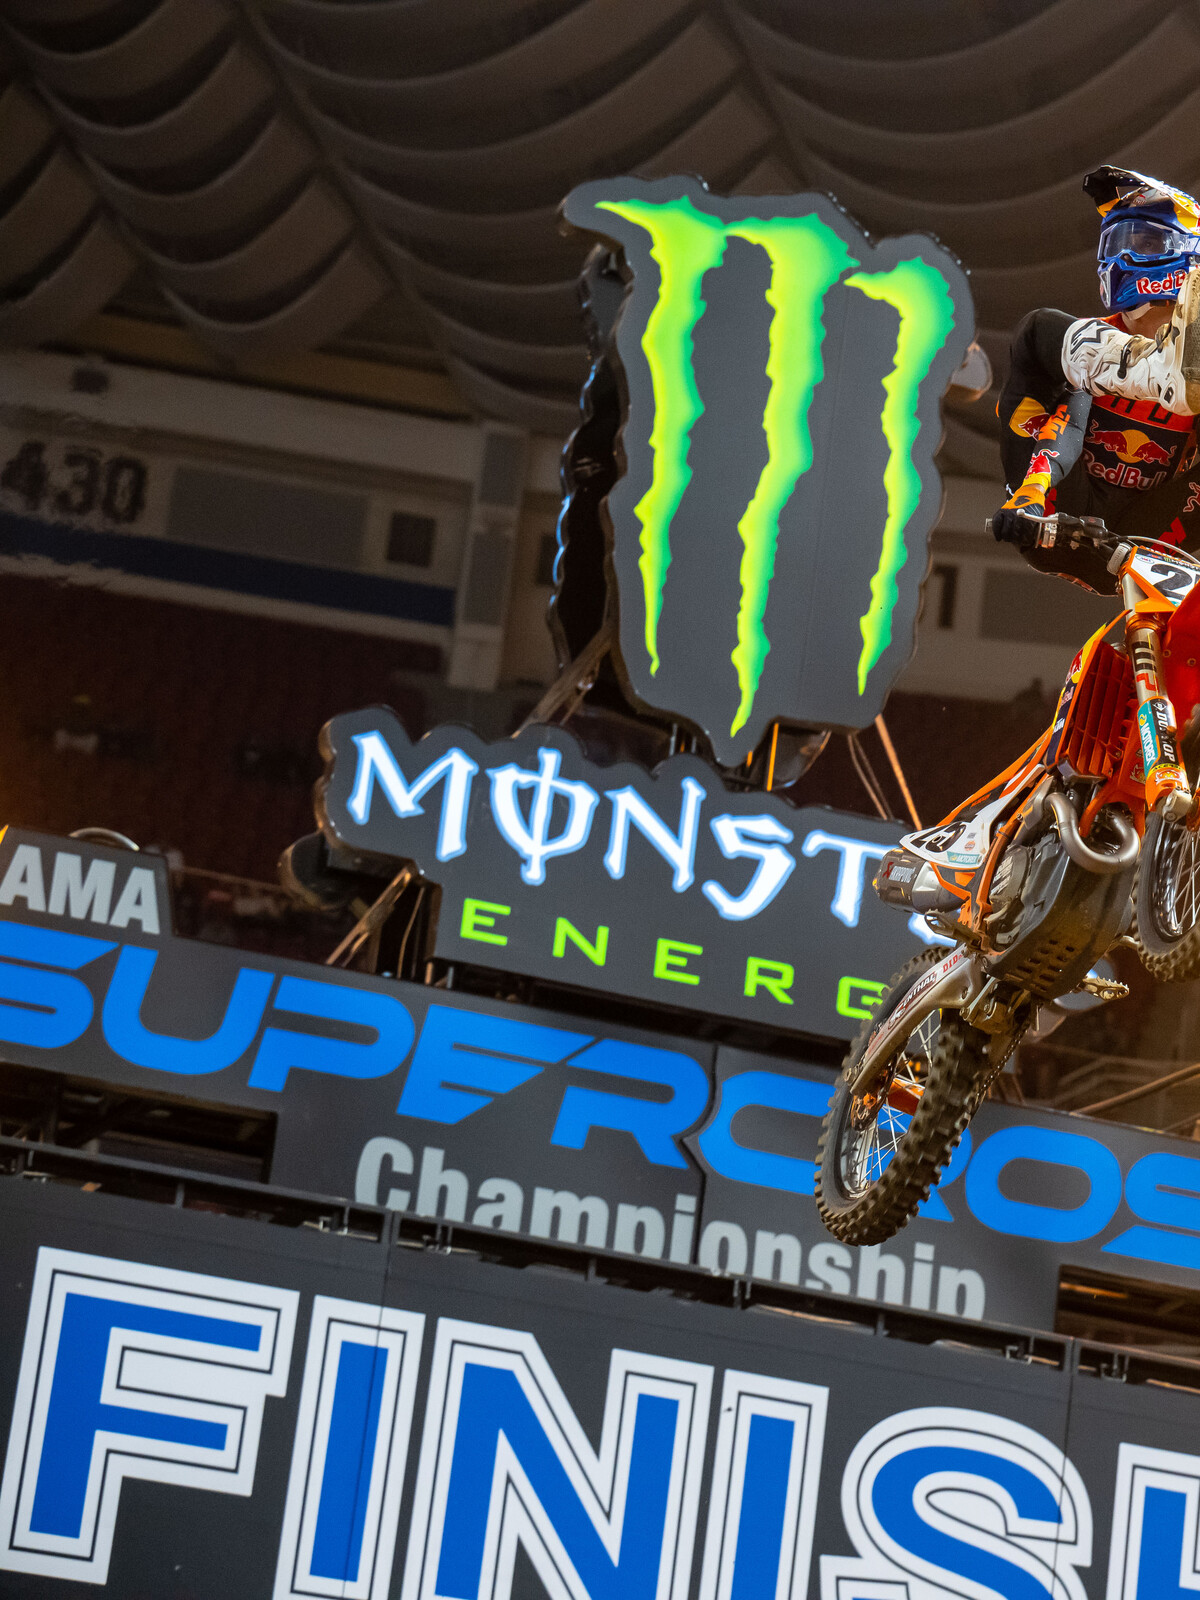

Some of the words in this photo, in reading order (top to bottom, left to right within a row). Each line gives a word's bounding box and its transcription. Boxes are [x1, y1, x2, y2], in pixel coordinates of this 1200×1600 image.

[1136, 272, 1173, 294] Red
[3, 440, 149, 525] 430
[1080, 447, 1126, 486] Red
[1140, 722, 1156, 766] MOTOREX
[1156, 711, 1176, 762] DUOP
[347, 731, 957, 946] MONST
[0, 844, 160, 935] AMA
[460, 898, 889, 1020] ENERG
[943, 954, 958, 973] DID
[355, 1137, 985, 1321] Championship
